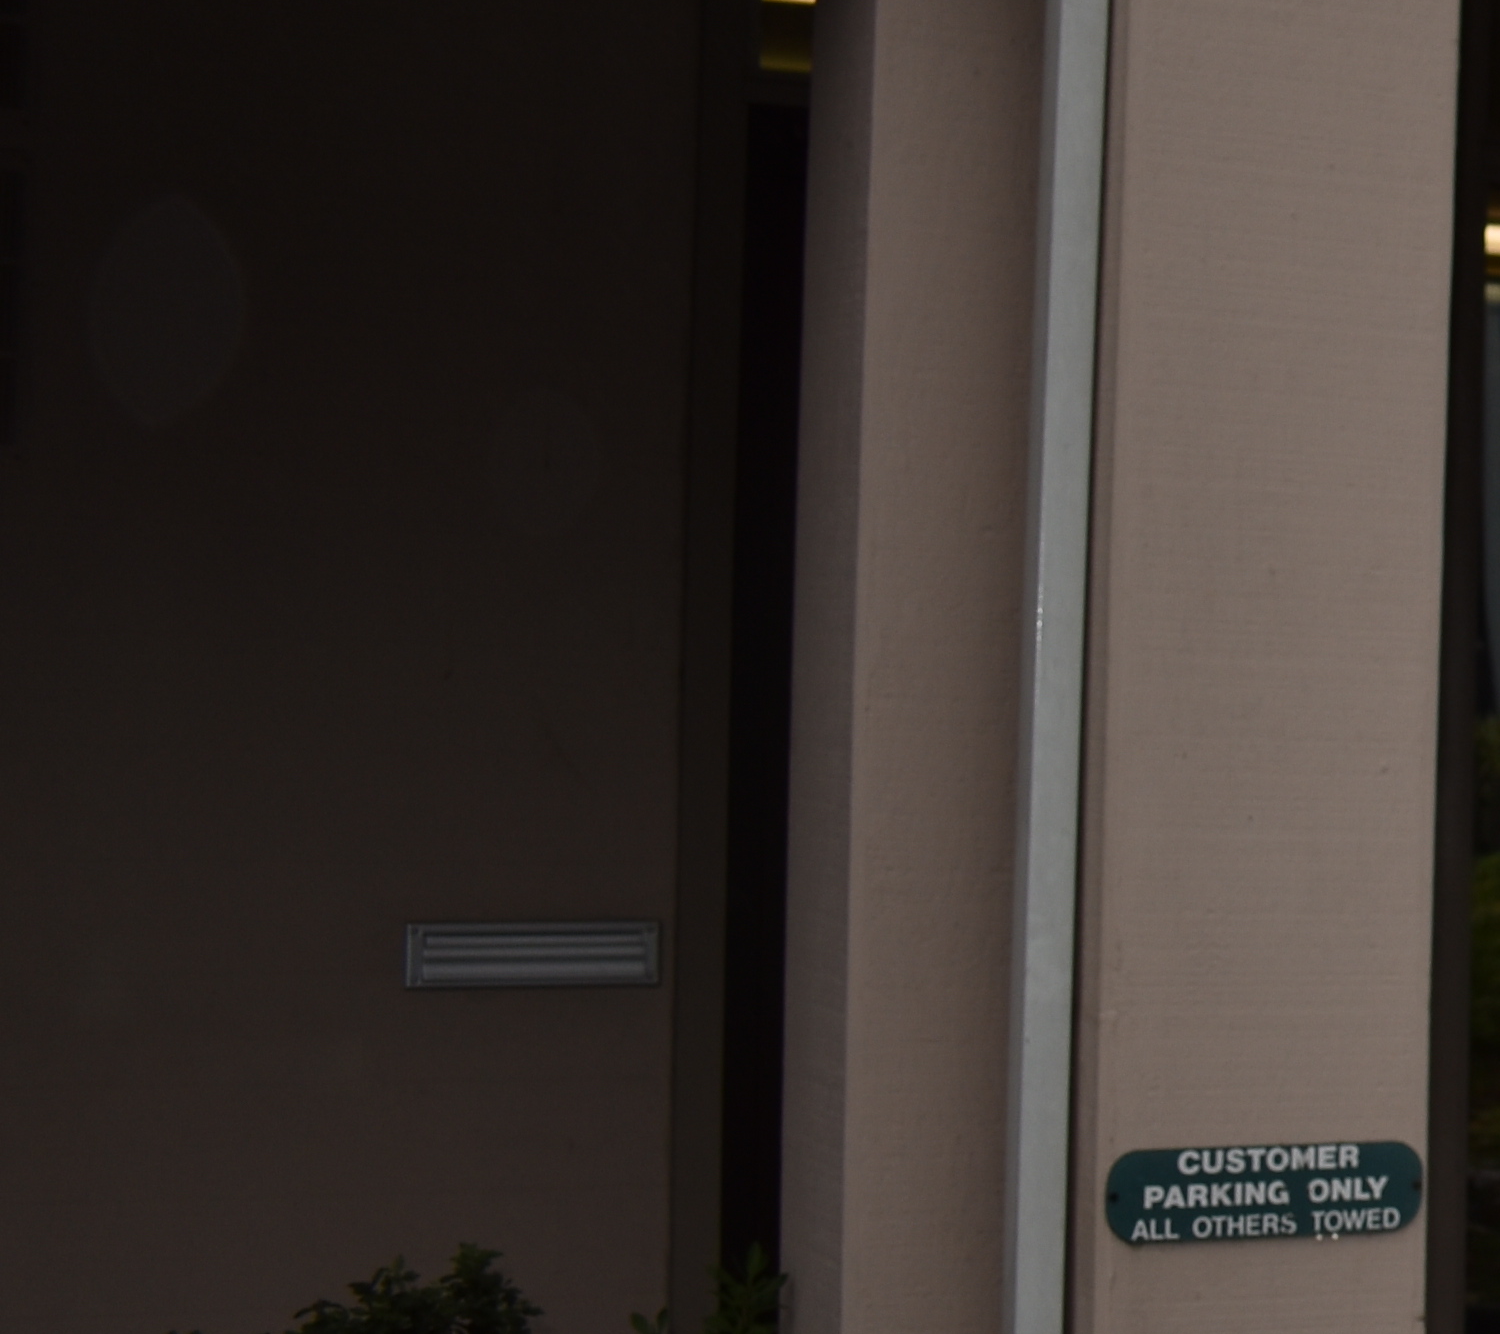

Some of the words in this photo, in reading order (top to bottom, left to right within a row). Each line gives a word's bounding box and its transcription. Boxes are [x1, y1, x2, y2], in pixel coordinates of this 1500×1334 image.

[1177, 1144, 1359, 1175] CUSTOMER
[1143, 1180, 1290, 1209] PARKING
[1309, 1175, 1389, 1203] ONLY
[1131, 1219, 1180, 1242] ALL
[1192, 1213, 1298, 1238] OTHERS
[1312, 1206, 1401, 1232] TOWED
